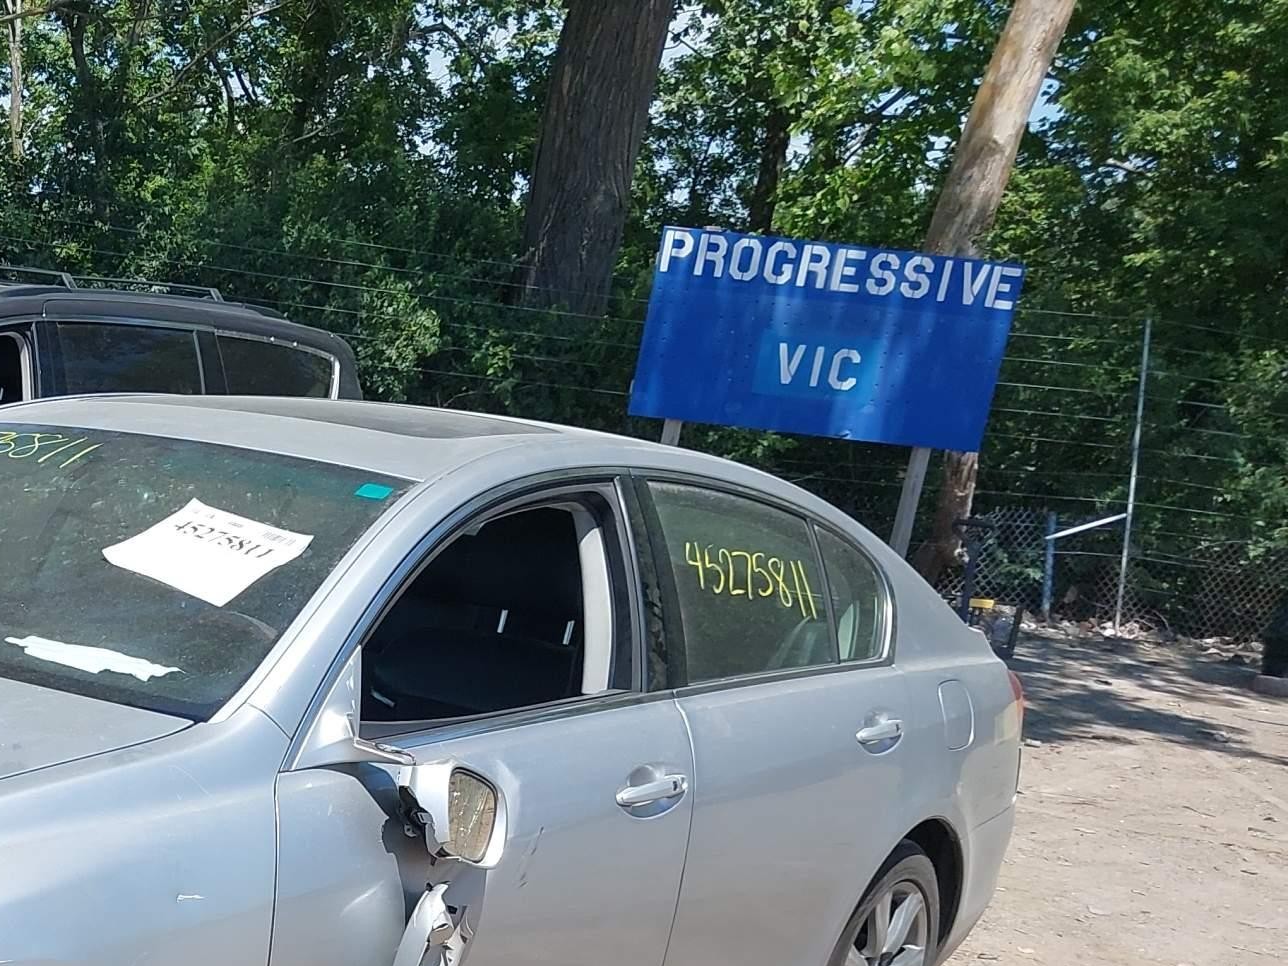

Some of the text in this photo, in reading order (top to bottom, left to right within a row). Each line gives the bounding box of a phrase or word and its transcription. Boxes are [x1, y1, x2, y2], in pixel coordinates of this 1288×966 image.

[659, 228, 1023, 311] PROGRESSIVE
[778, 342, 863, 391] VIC
[174, 520, 276, 558] 45275811
[685, 541, 818, 620] 45275811
